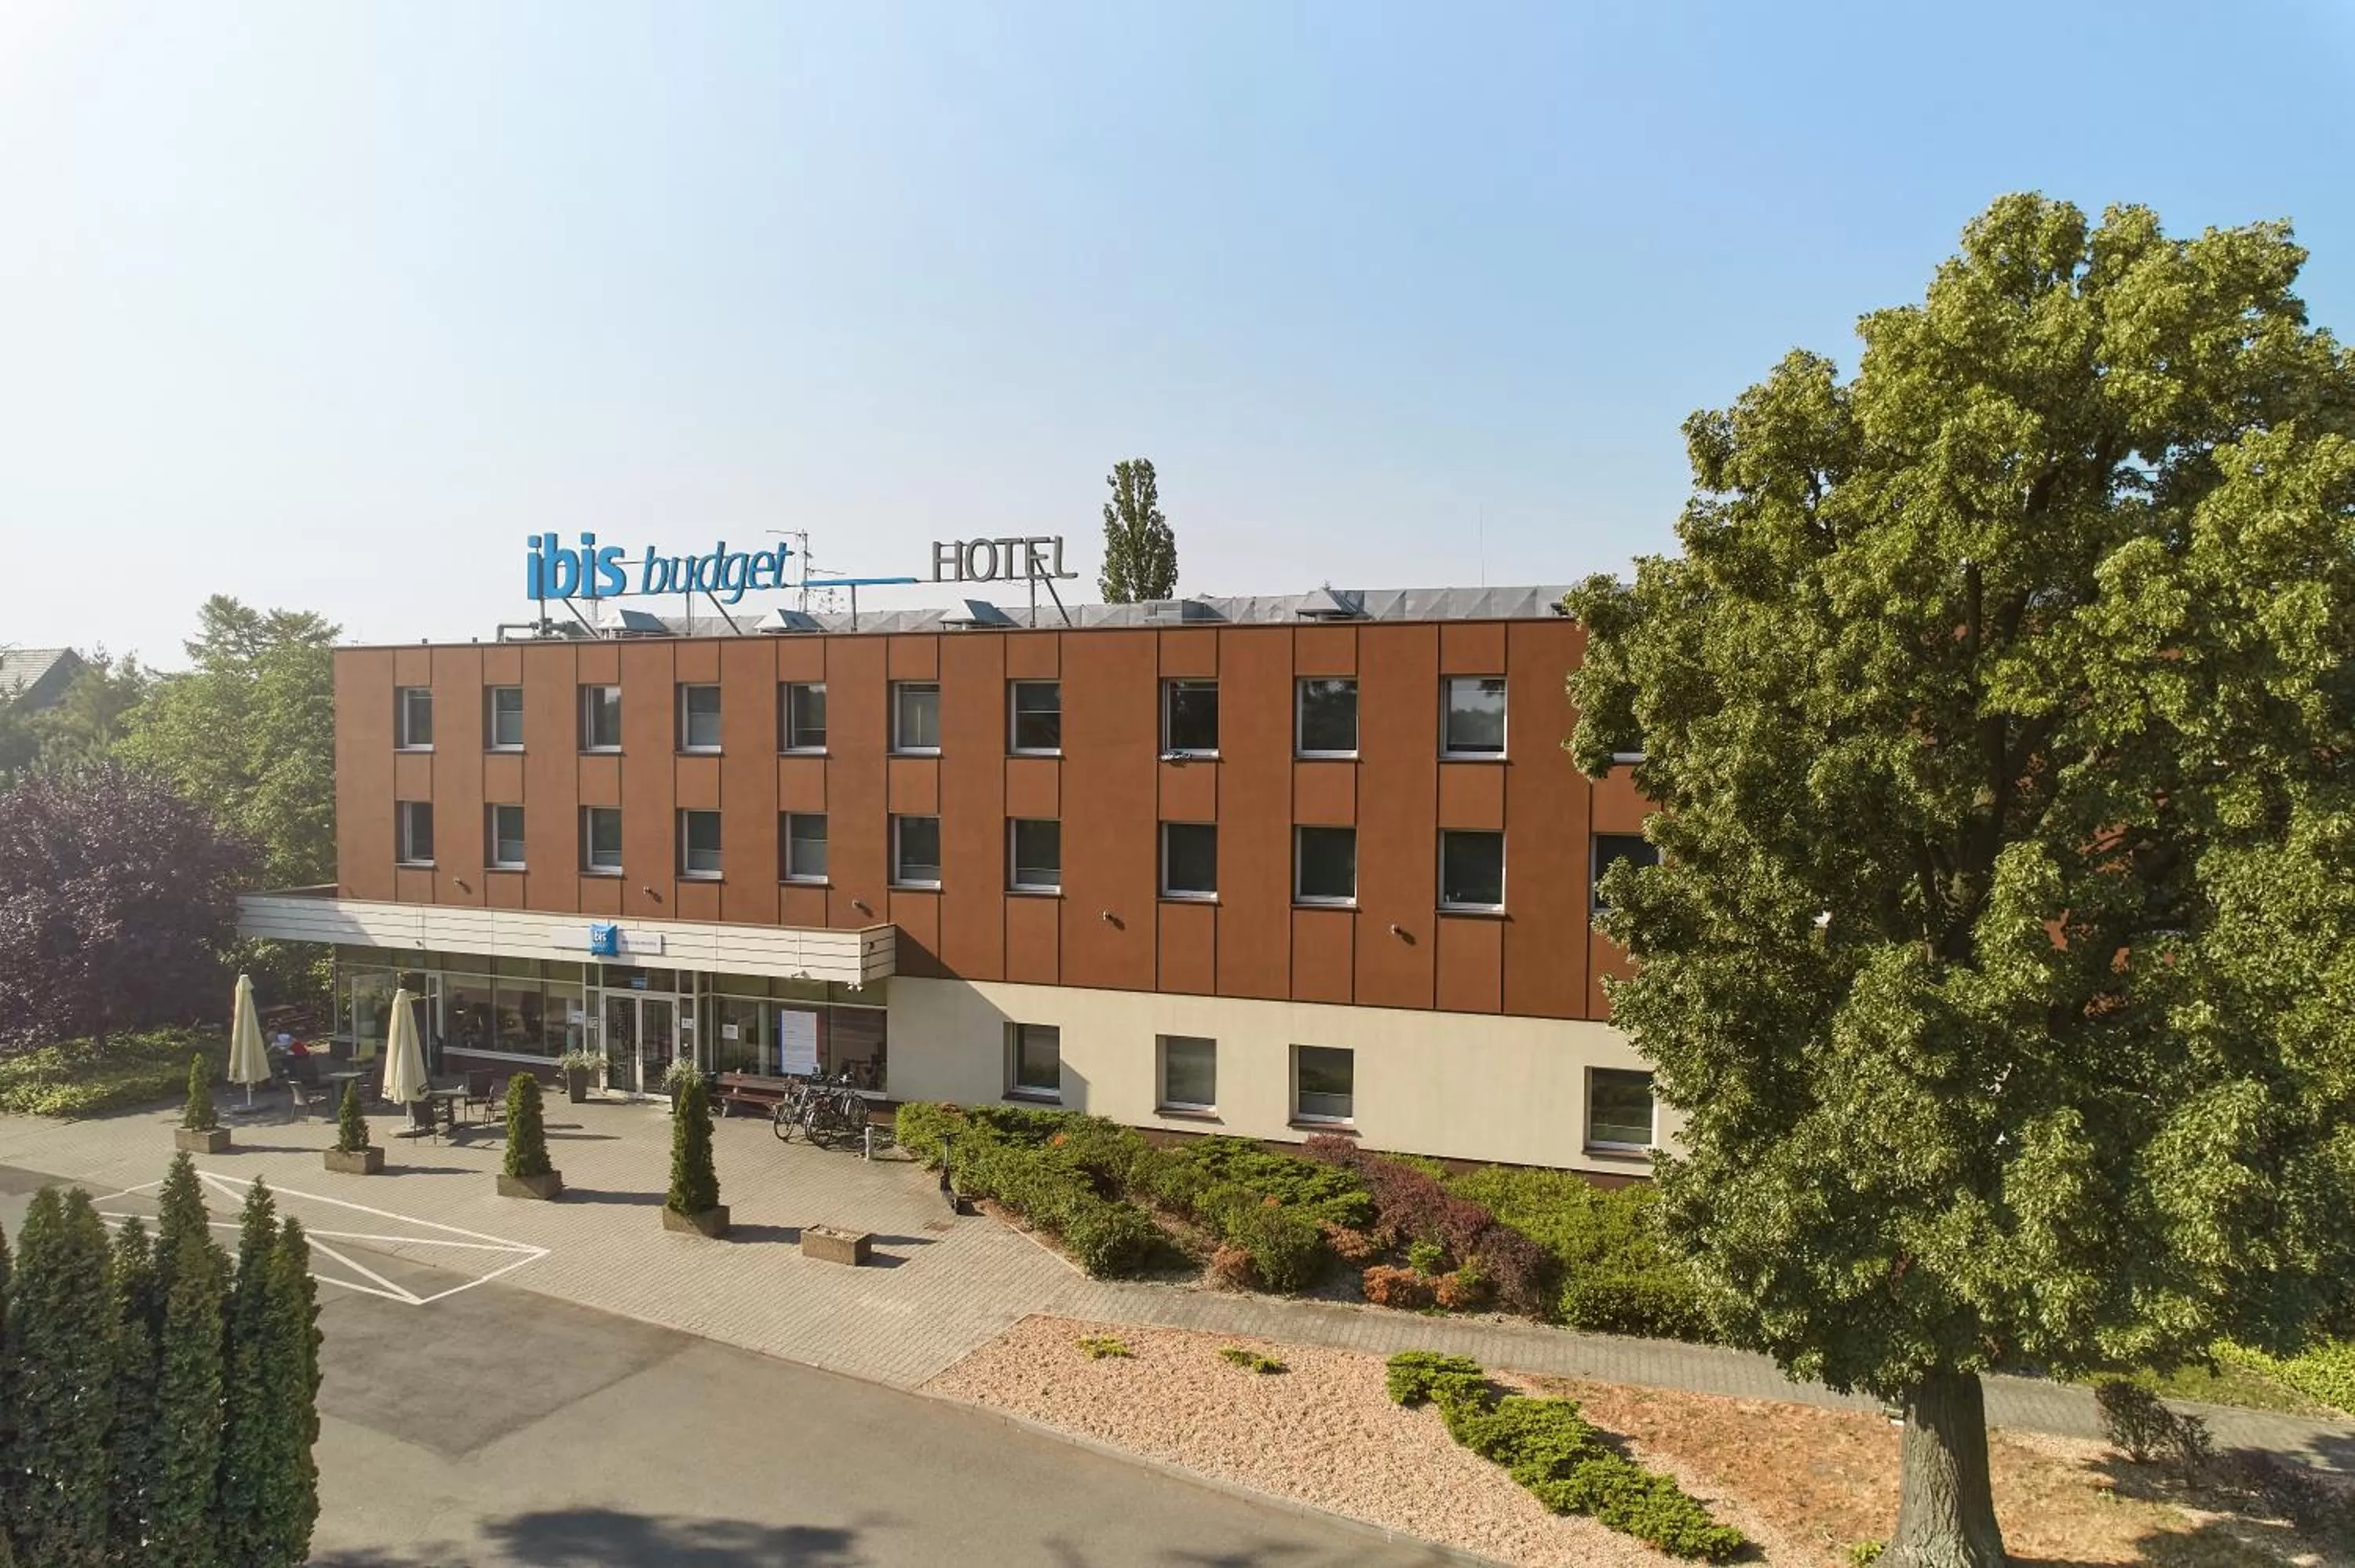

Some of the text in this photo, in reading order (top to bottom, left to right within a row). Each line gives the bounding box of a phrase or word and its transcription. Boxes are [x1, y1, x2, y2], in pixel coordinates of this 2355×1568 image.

[528, 533, 794, 603] ibis budget
[933, 535, 1079, 582] HOTEL
